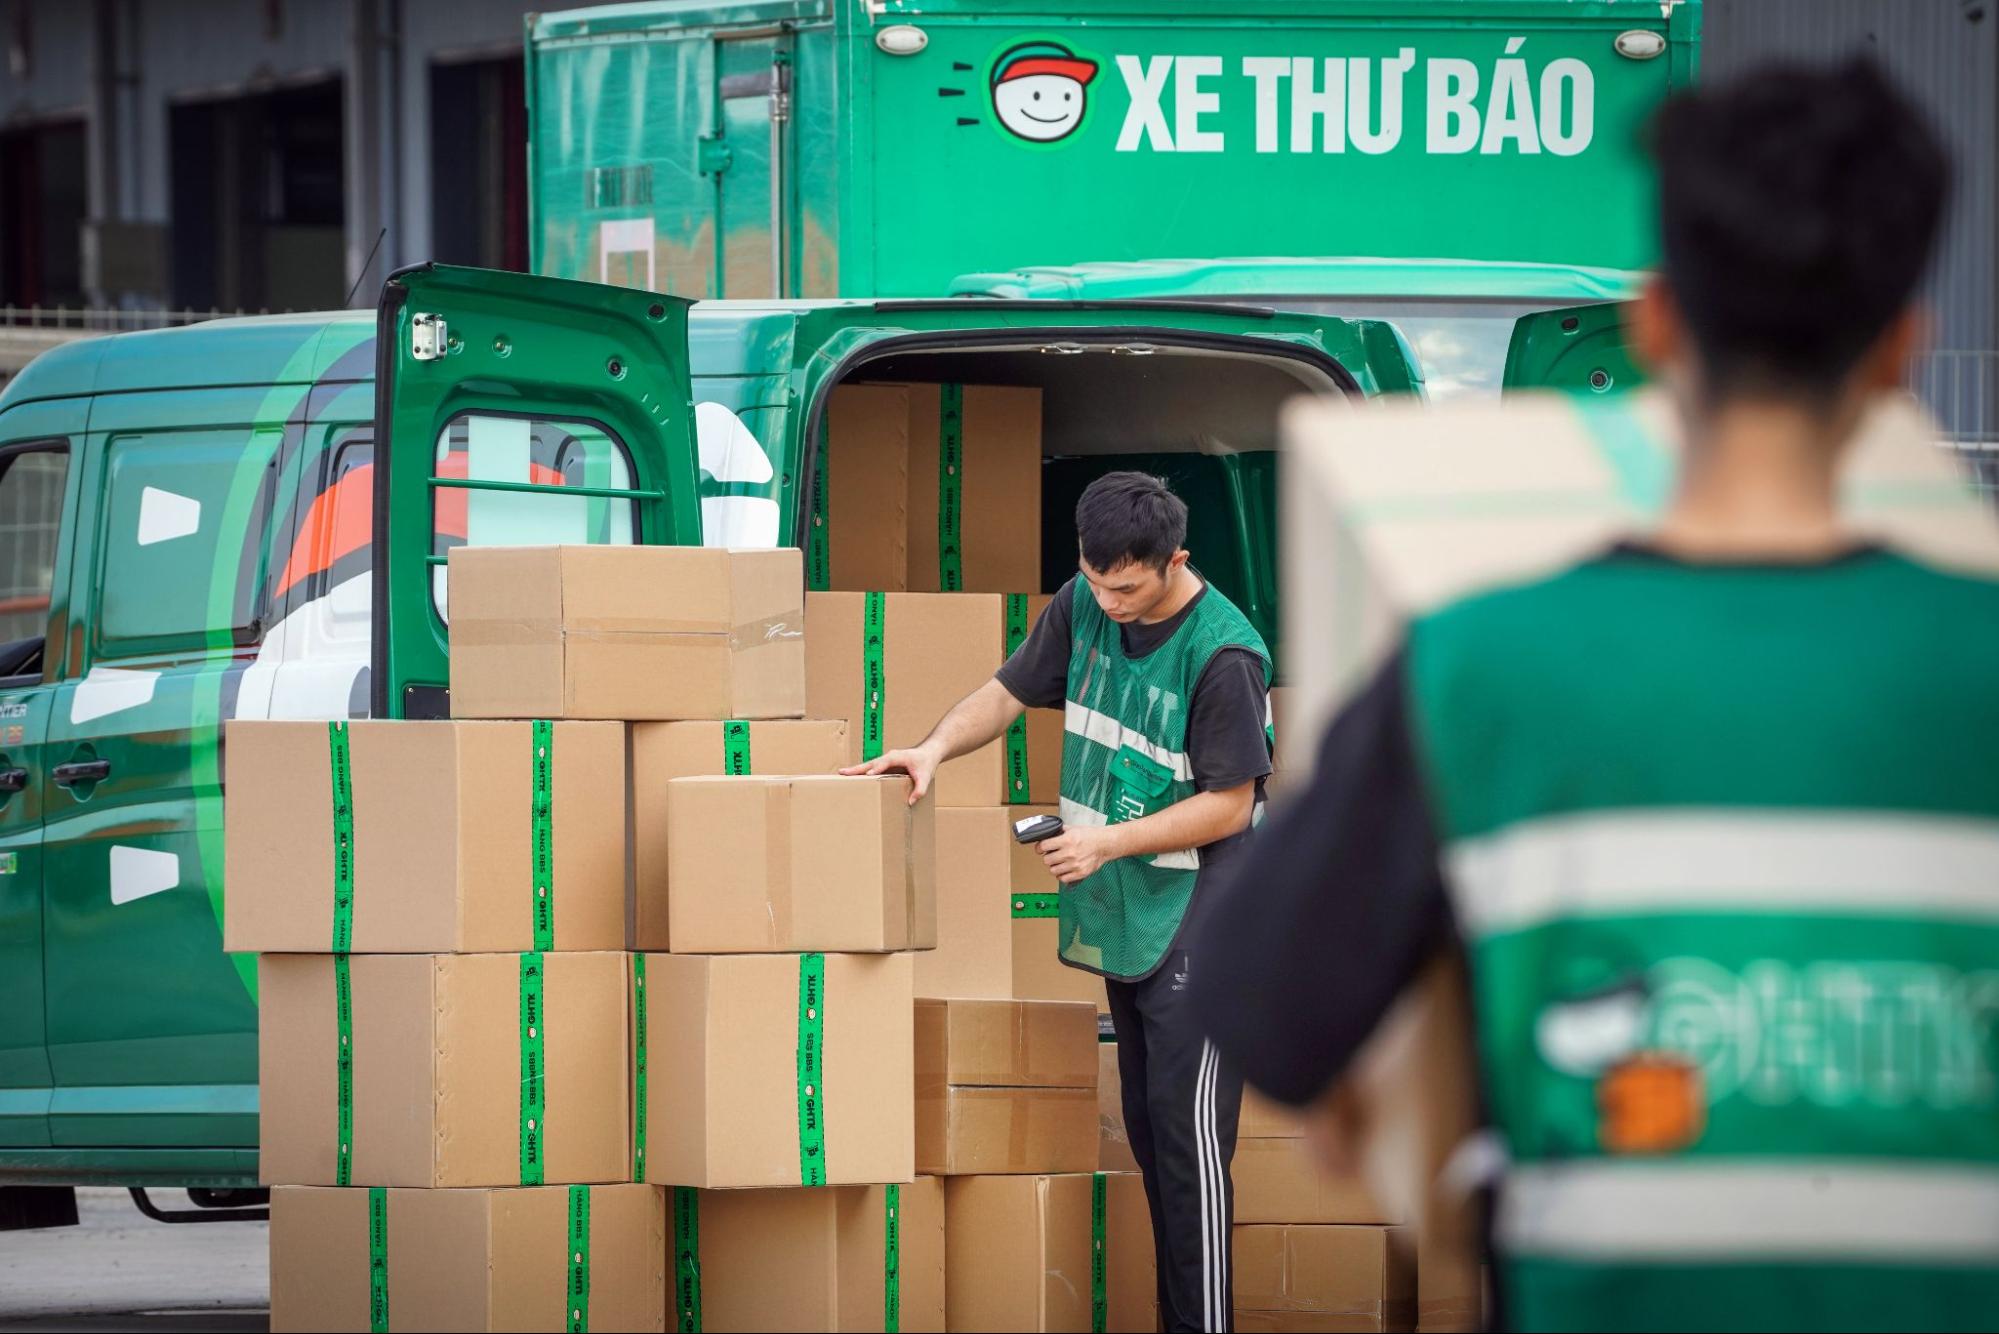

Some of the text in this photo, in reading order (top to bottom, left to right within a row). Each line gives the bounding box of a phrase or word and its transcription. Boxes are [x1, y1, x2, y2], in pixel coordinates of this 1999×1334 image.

[1115, 37, 1594, 156] XE THƯ BÁO
[734, 752, 742, 775] HTK
[807, 975, 816, 1005] GHTK
[806, 1099, 815, 1130] GHTK
